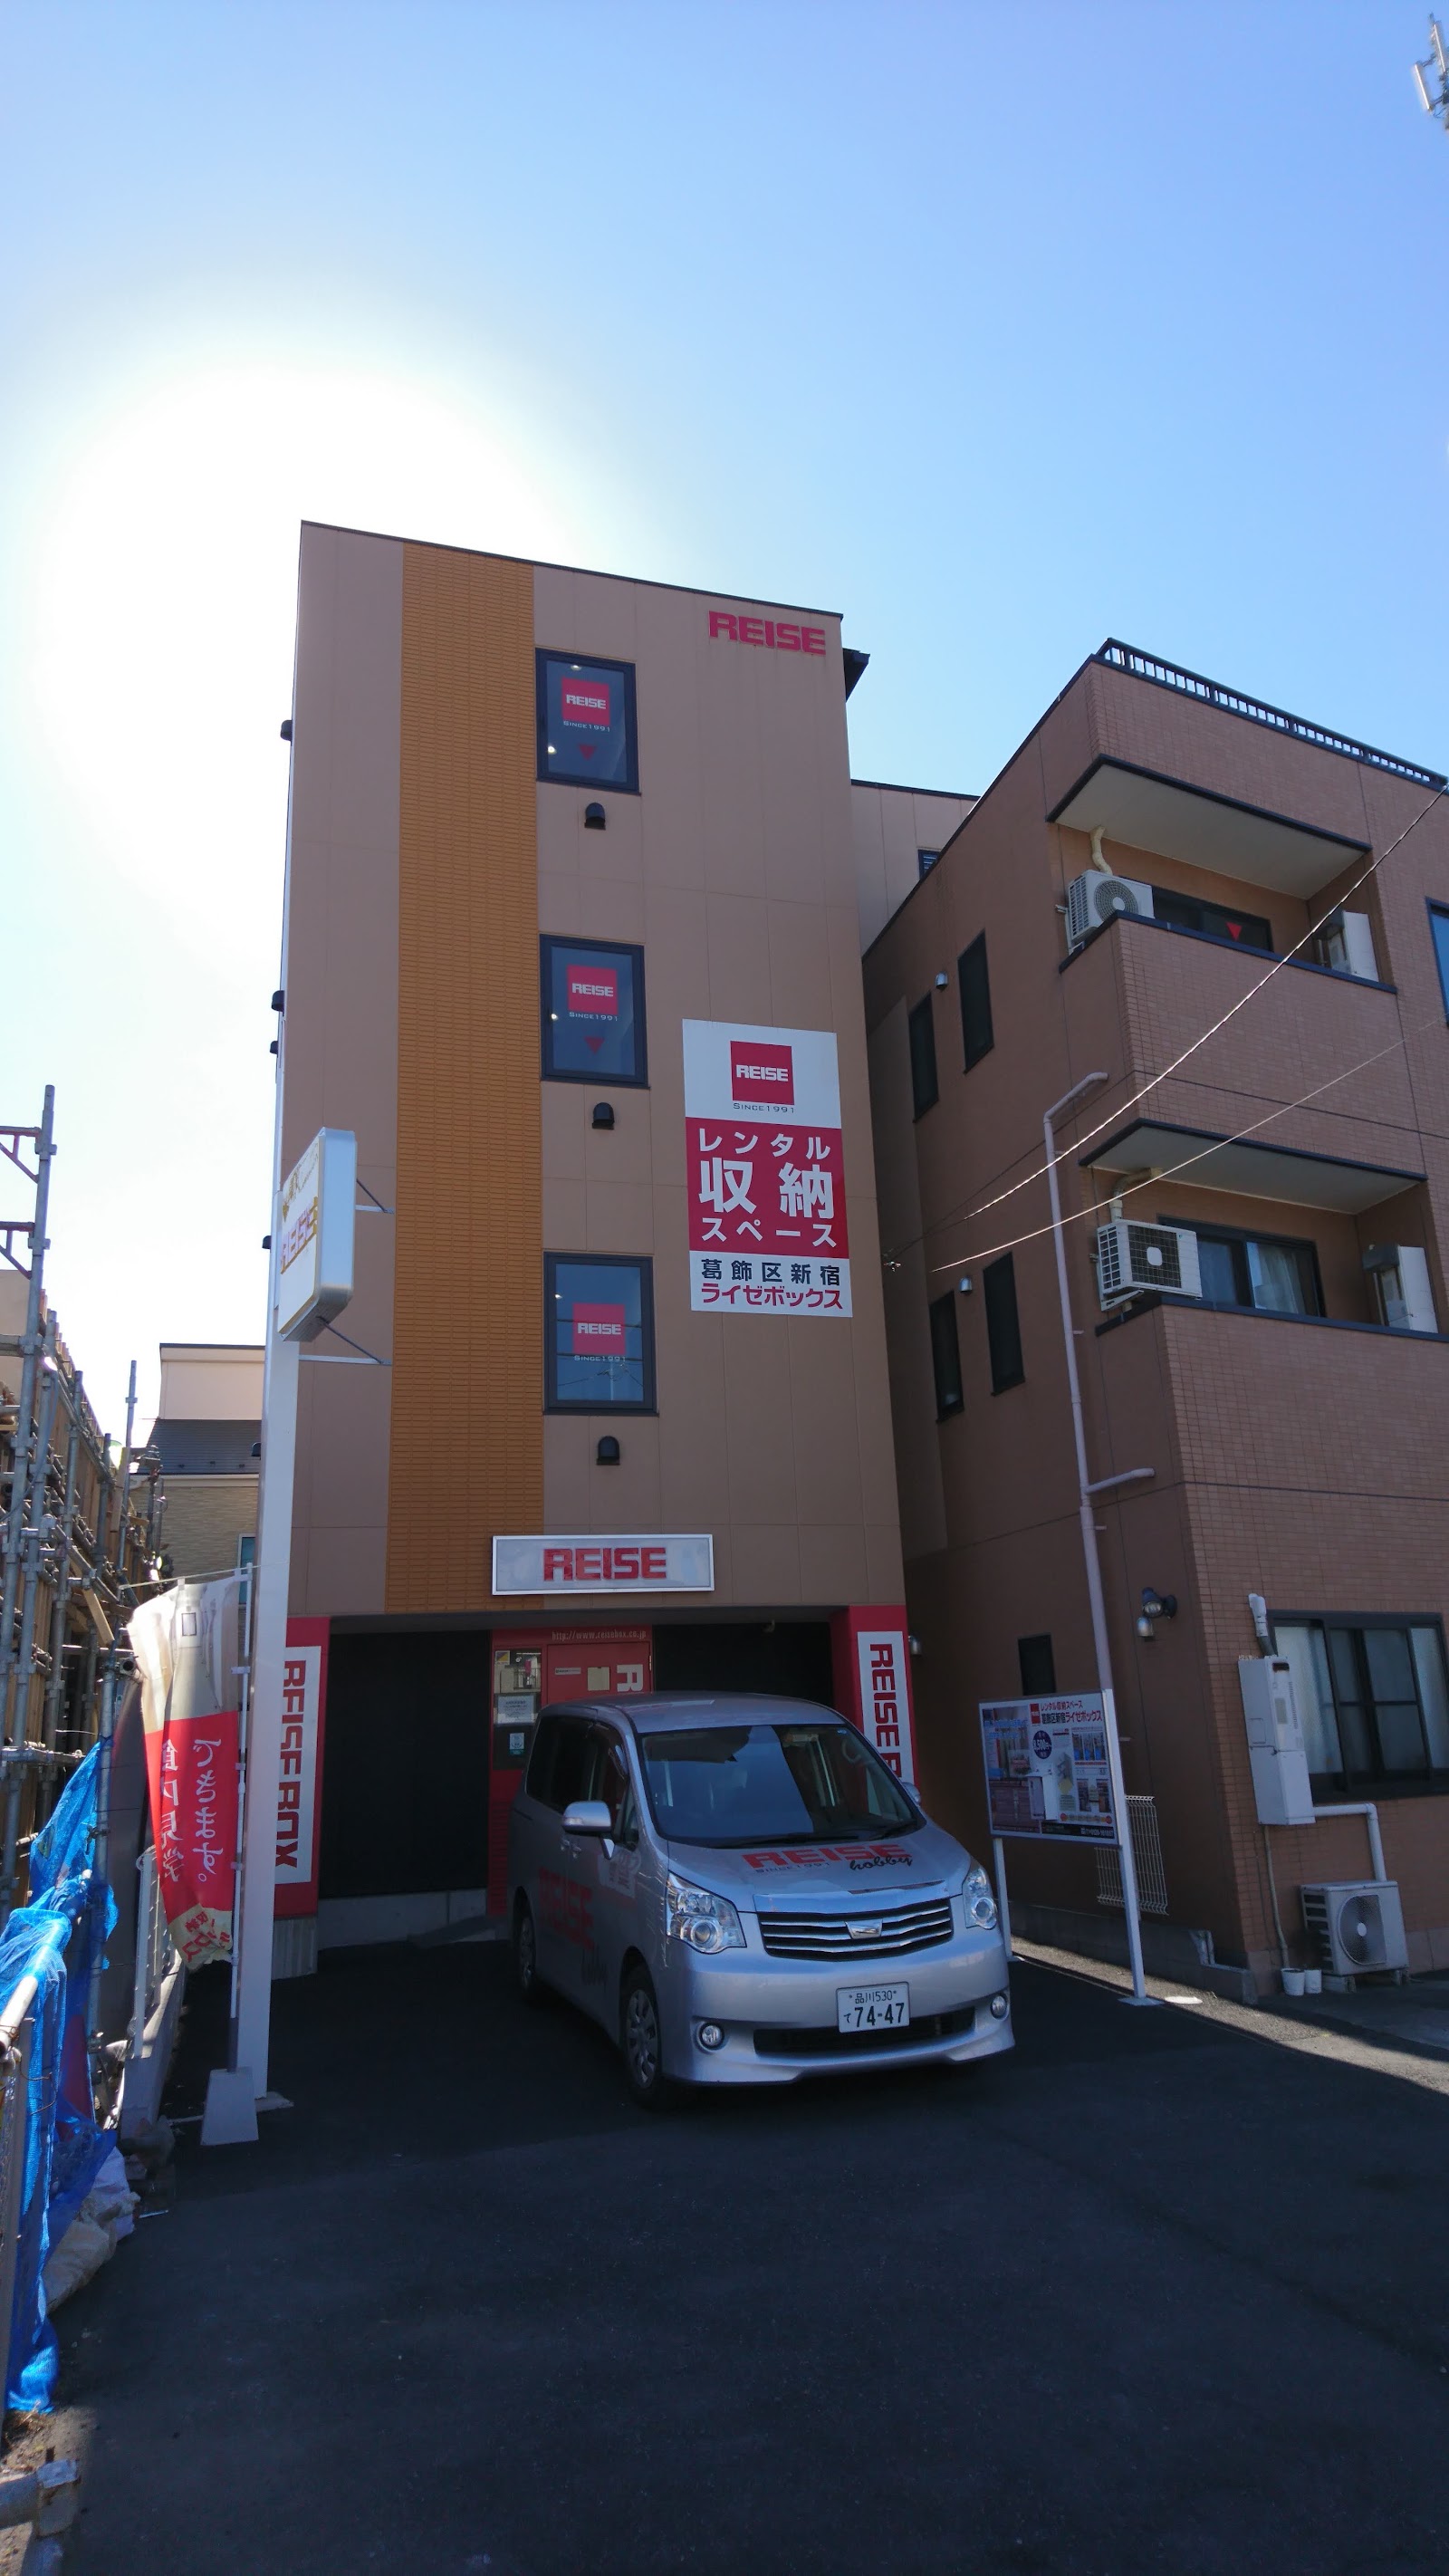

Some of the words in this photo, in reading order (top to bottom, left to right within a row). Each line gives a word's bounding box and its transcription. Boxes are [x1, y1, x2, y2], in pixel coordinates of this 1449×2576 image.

[708, 610, 826, 656] REISE
[565, 693, 607, 710] REISE
[571, 982, 614, 998] REISE
[735, 1064, 789, 1082] REISE
[698, 1128, 830, 1160] レンタル
[698, 1157, 835, 1220] 収納
[701, 1216, 838, 1248] スペース
[701, 1258, 840, 1286] 葛飾区新宿
[701, 1283, 843, 1310] ライゼボックス
[577, 1322, 621, 1335] REISE
[543, 1547, 667, 1581] REISE
[869, 1644, 900, 1747] REISE
[742, 1844, 912, 1870] REISE
[854, 2003, 905, 2028] 74-47
